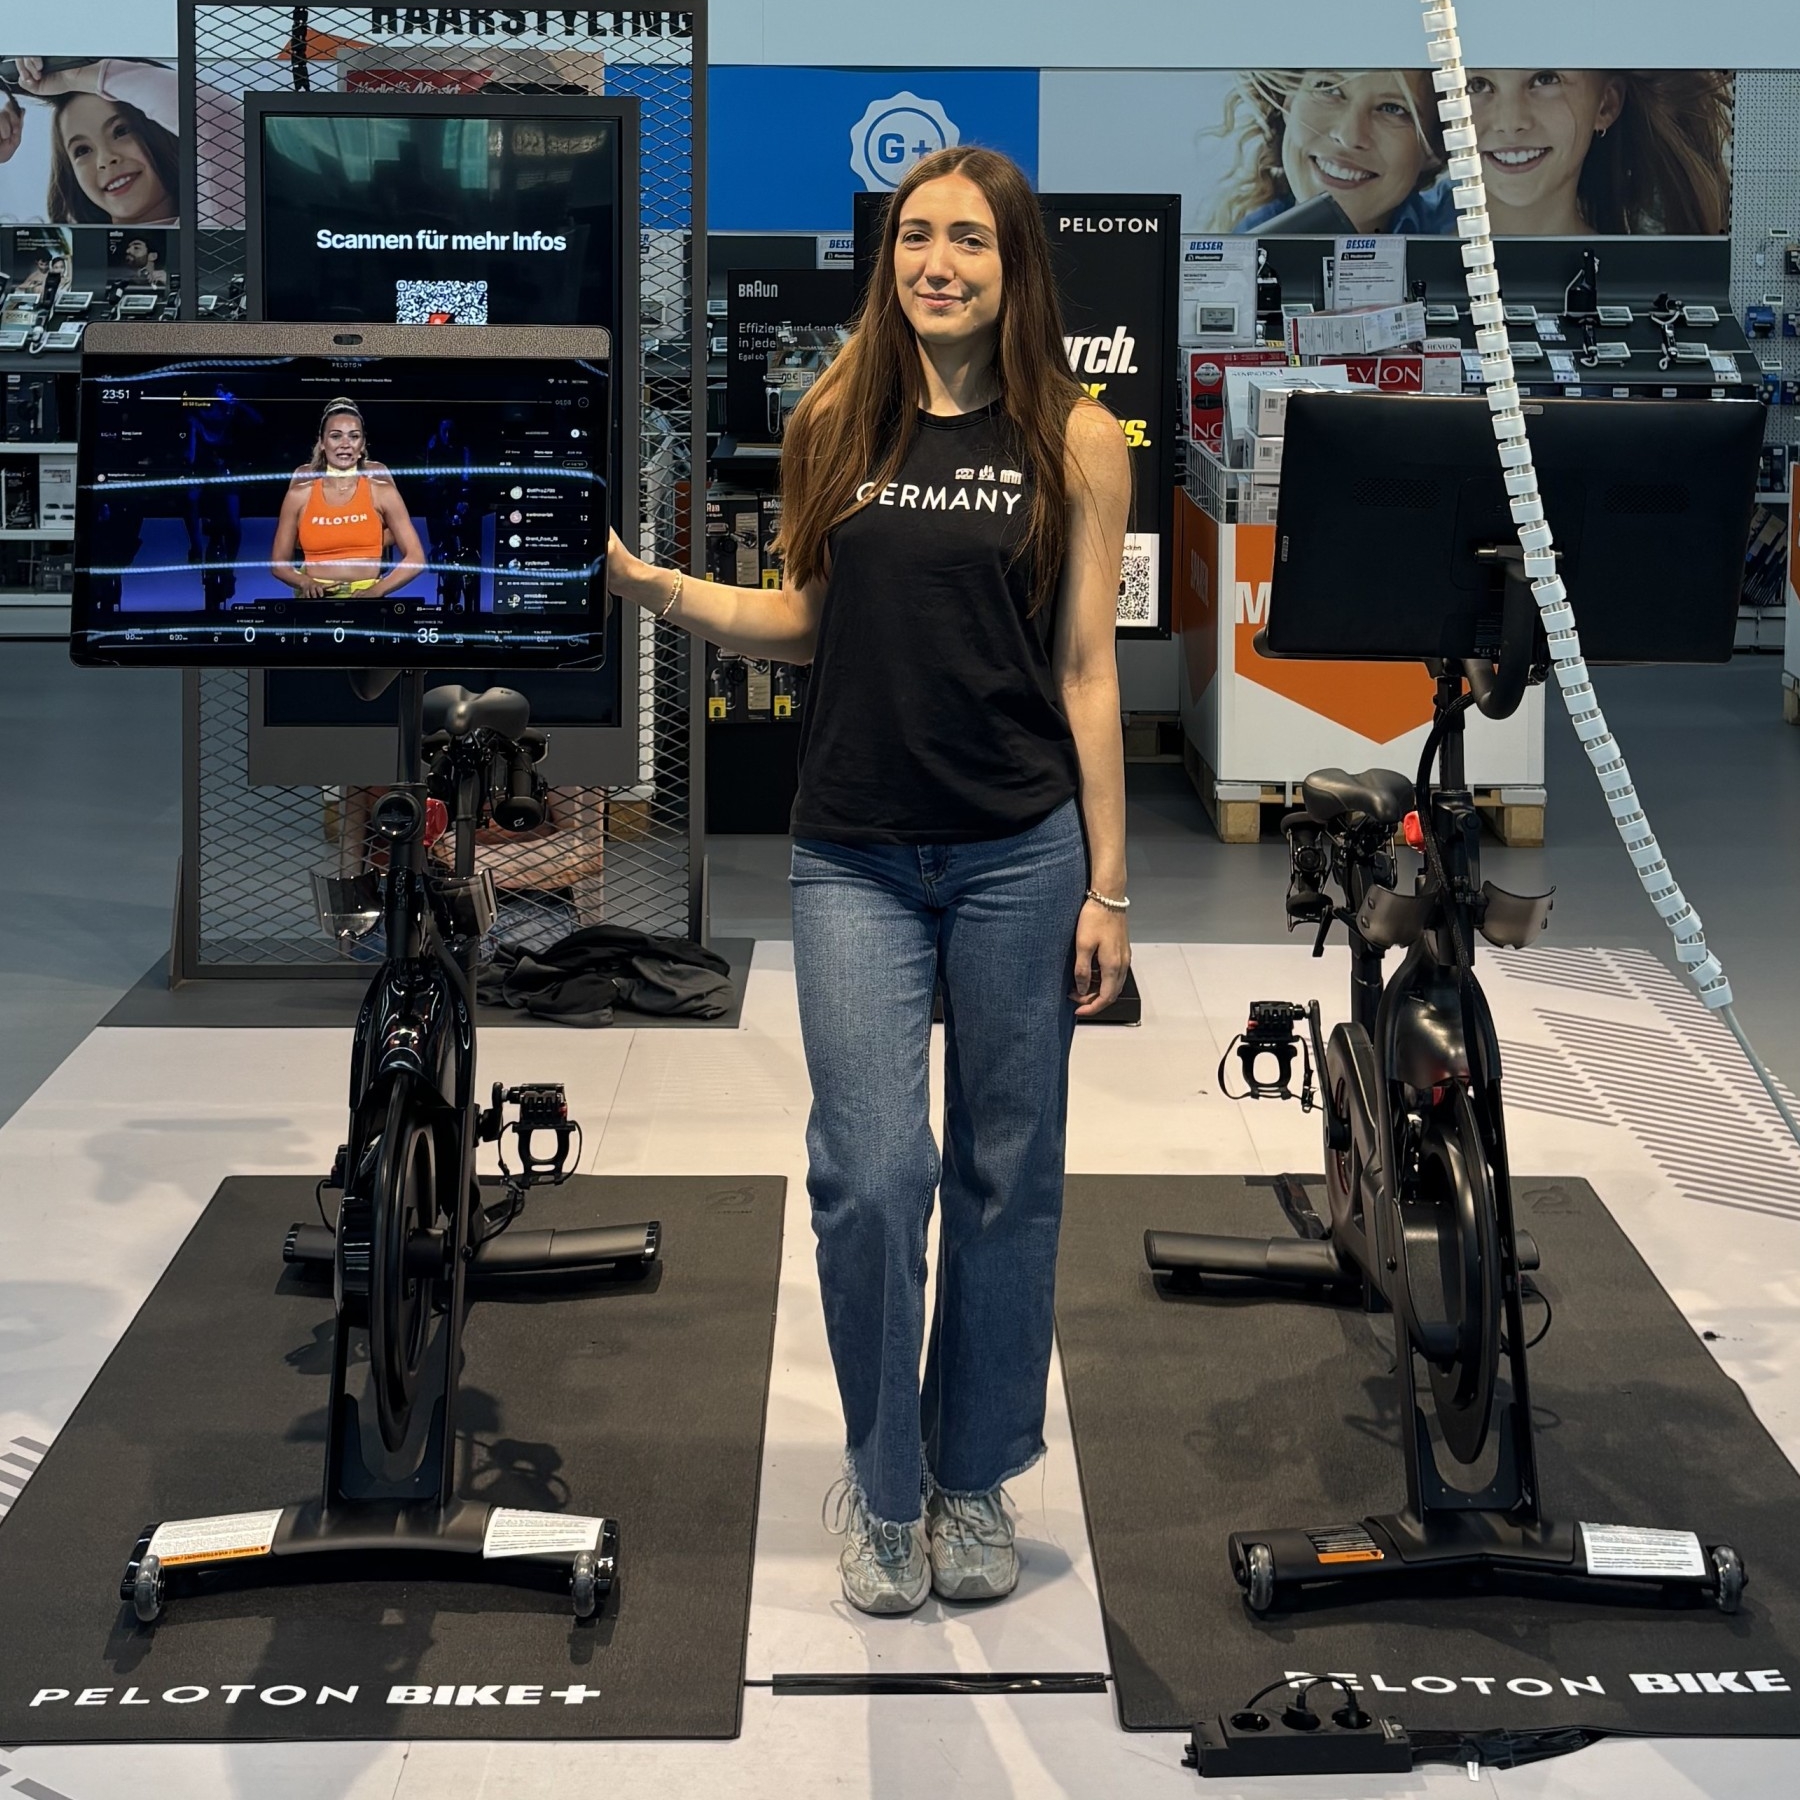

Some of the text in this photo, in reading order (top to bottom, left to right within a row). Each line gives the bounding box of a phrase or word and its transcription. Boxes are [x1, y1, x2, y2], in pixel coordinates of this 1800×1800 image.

[1059, 217, 1159, 233] PELOTON
[316, 229, 567, 251] Scannen für mehr Infos
[1189, 241, 1223, 251] BESSER
[1346, 239, 1376, 249] BESSER
[738, 280, 778, 298] BRAUN
[738, 337, 749, 348] in
[738, 353, 754, 362] Egal
[102, 389, 130, 400] 23:51
[856, 481, 1022, 515] GERMANY
[312, 514, 368, 526] PELOTON
[244, 627, 256, 643] 0
[334, 627, 345, 643] 0
[417, 627, 439, 644] 35
[1283, 1669, 1792, 1696] PELOTON BIKE
[30, 1684, 601, 1708] PELOTON BIKE+
